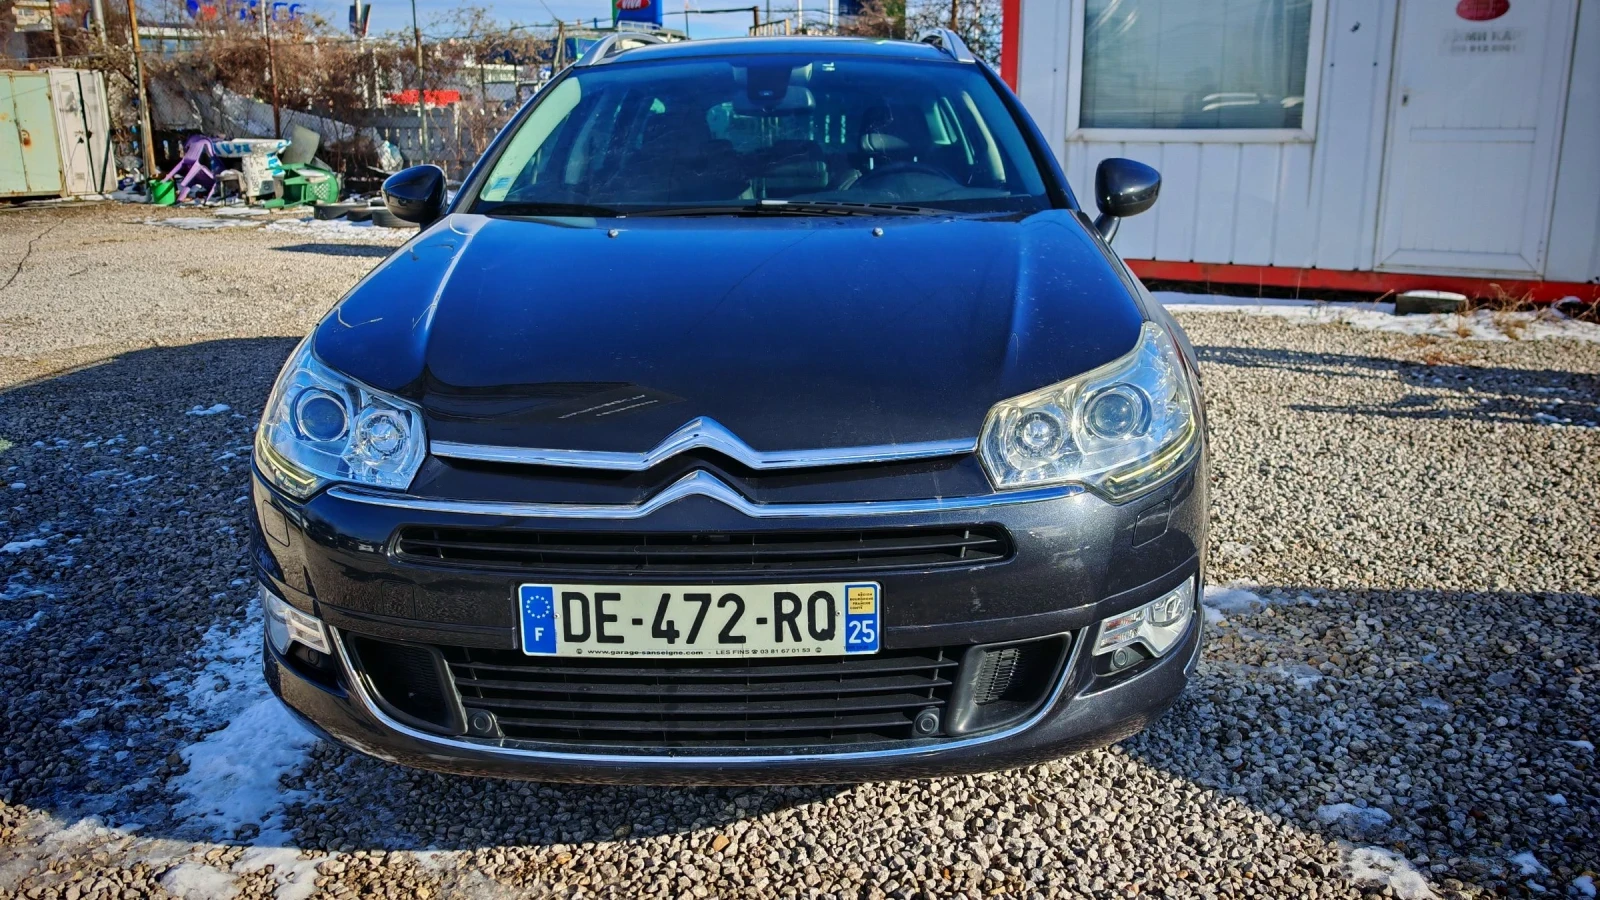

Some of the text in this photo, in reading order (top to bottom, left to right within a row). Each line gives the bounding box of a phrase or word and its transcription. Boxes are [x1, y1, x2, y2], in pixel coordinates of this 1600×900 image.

[561, 590, 836, 644] DE-472-RQ
[535, 627, 544, 641] F
[849, 620, 875, 643] 25
